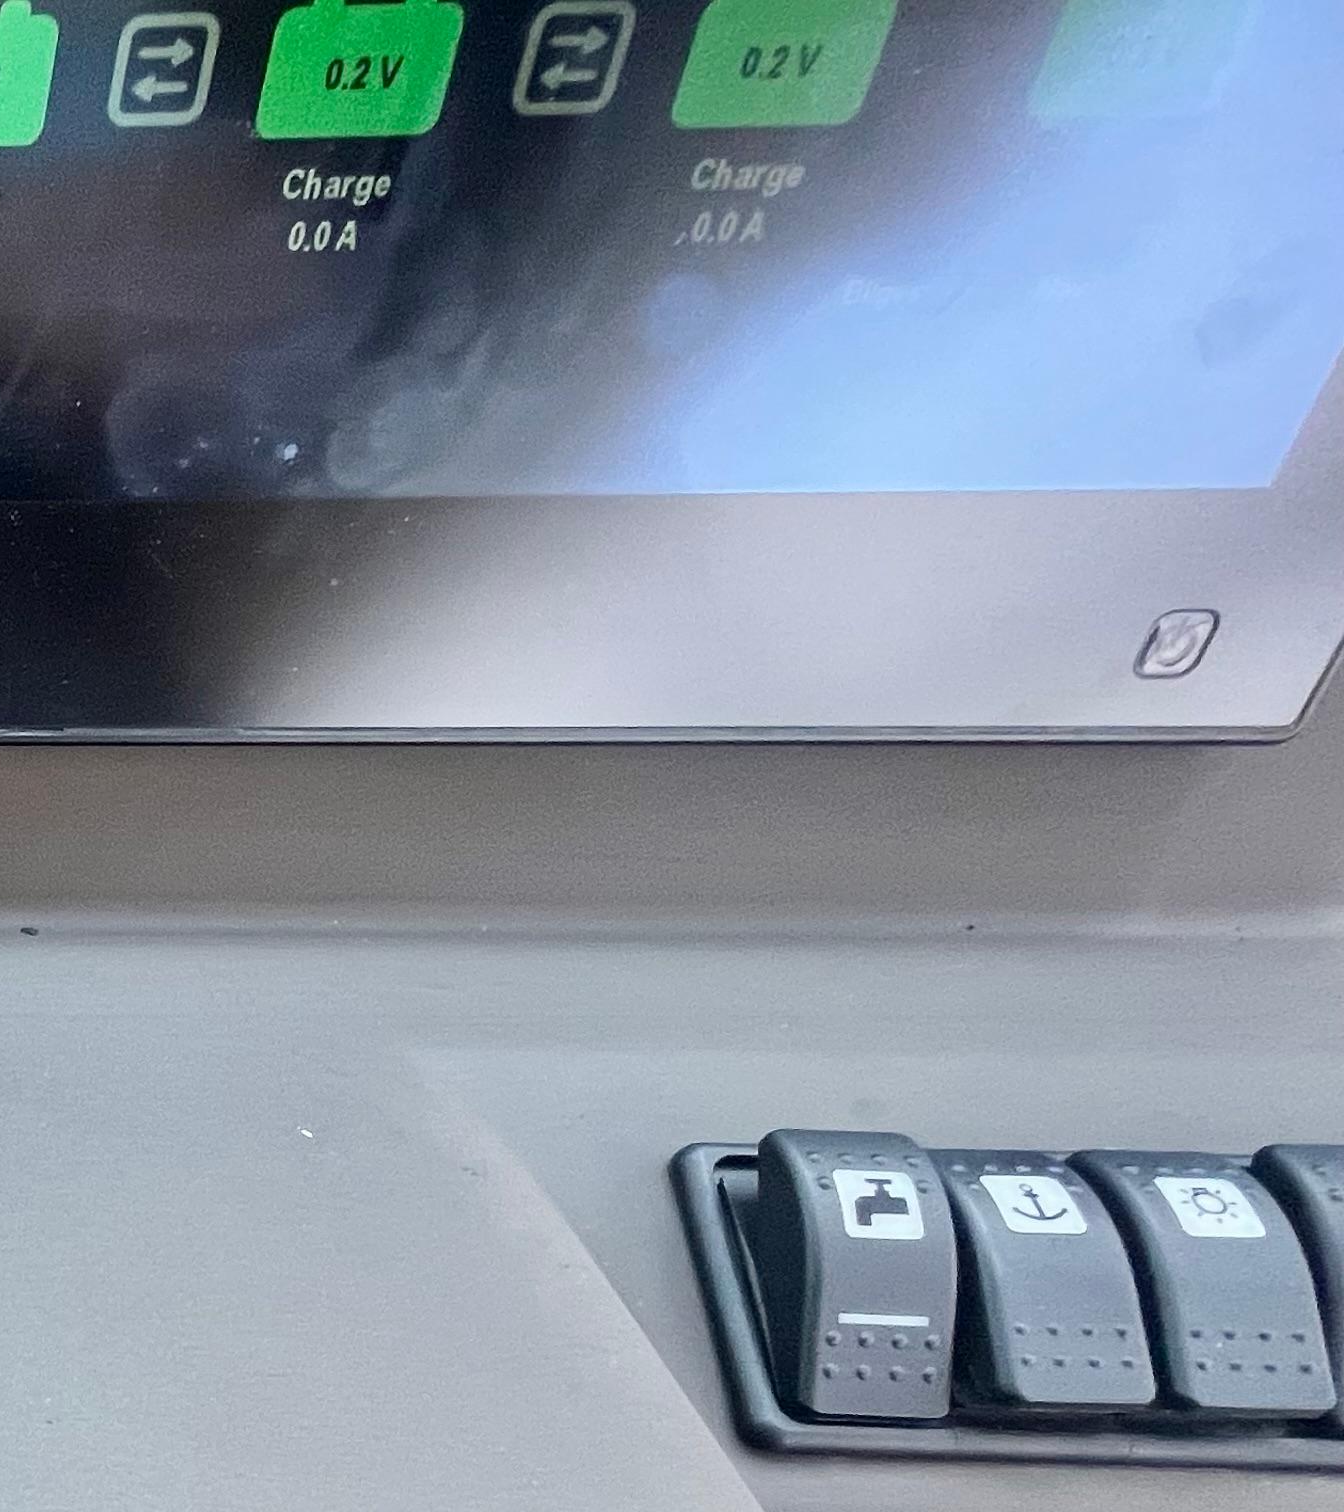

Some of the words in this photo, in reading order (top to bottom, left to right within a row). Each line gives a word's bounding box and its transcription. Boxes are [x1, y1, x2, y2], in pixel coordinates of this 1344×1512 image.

[323, 57, 372, 92] 0.2
[380, 55, 405, 90] V
[740, 45, 791, 80] 0.2
[797, 44, 824, 78] V
[282, 168, 392, 206] Charge
[690, 158, 806, 197] Charge
[287, 221, 331, 253] 0.0
[335, 220, 358, 252] A
[691, 212, 739, 245] 0.0
[742, 211, 766, 242] A
